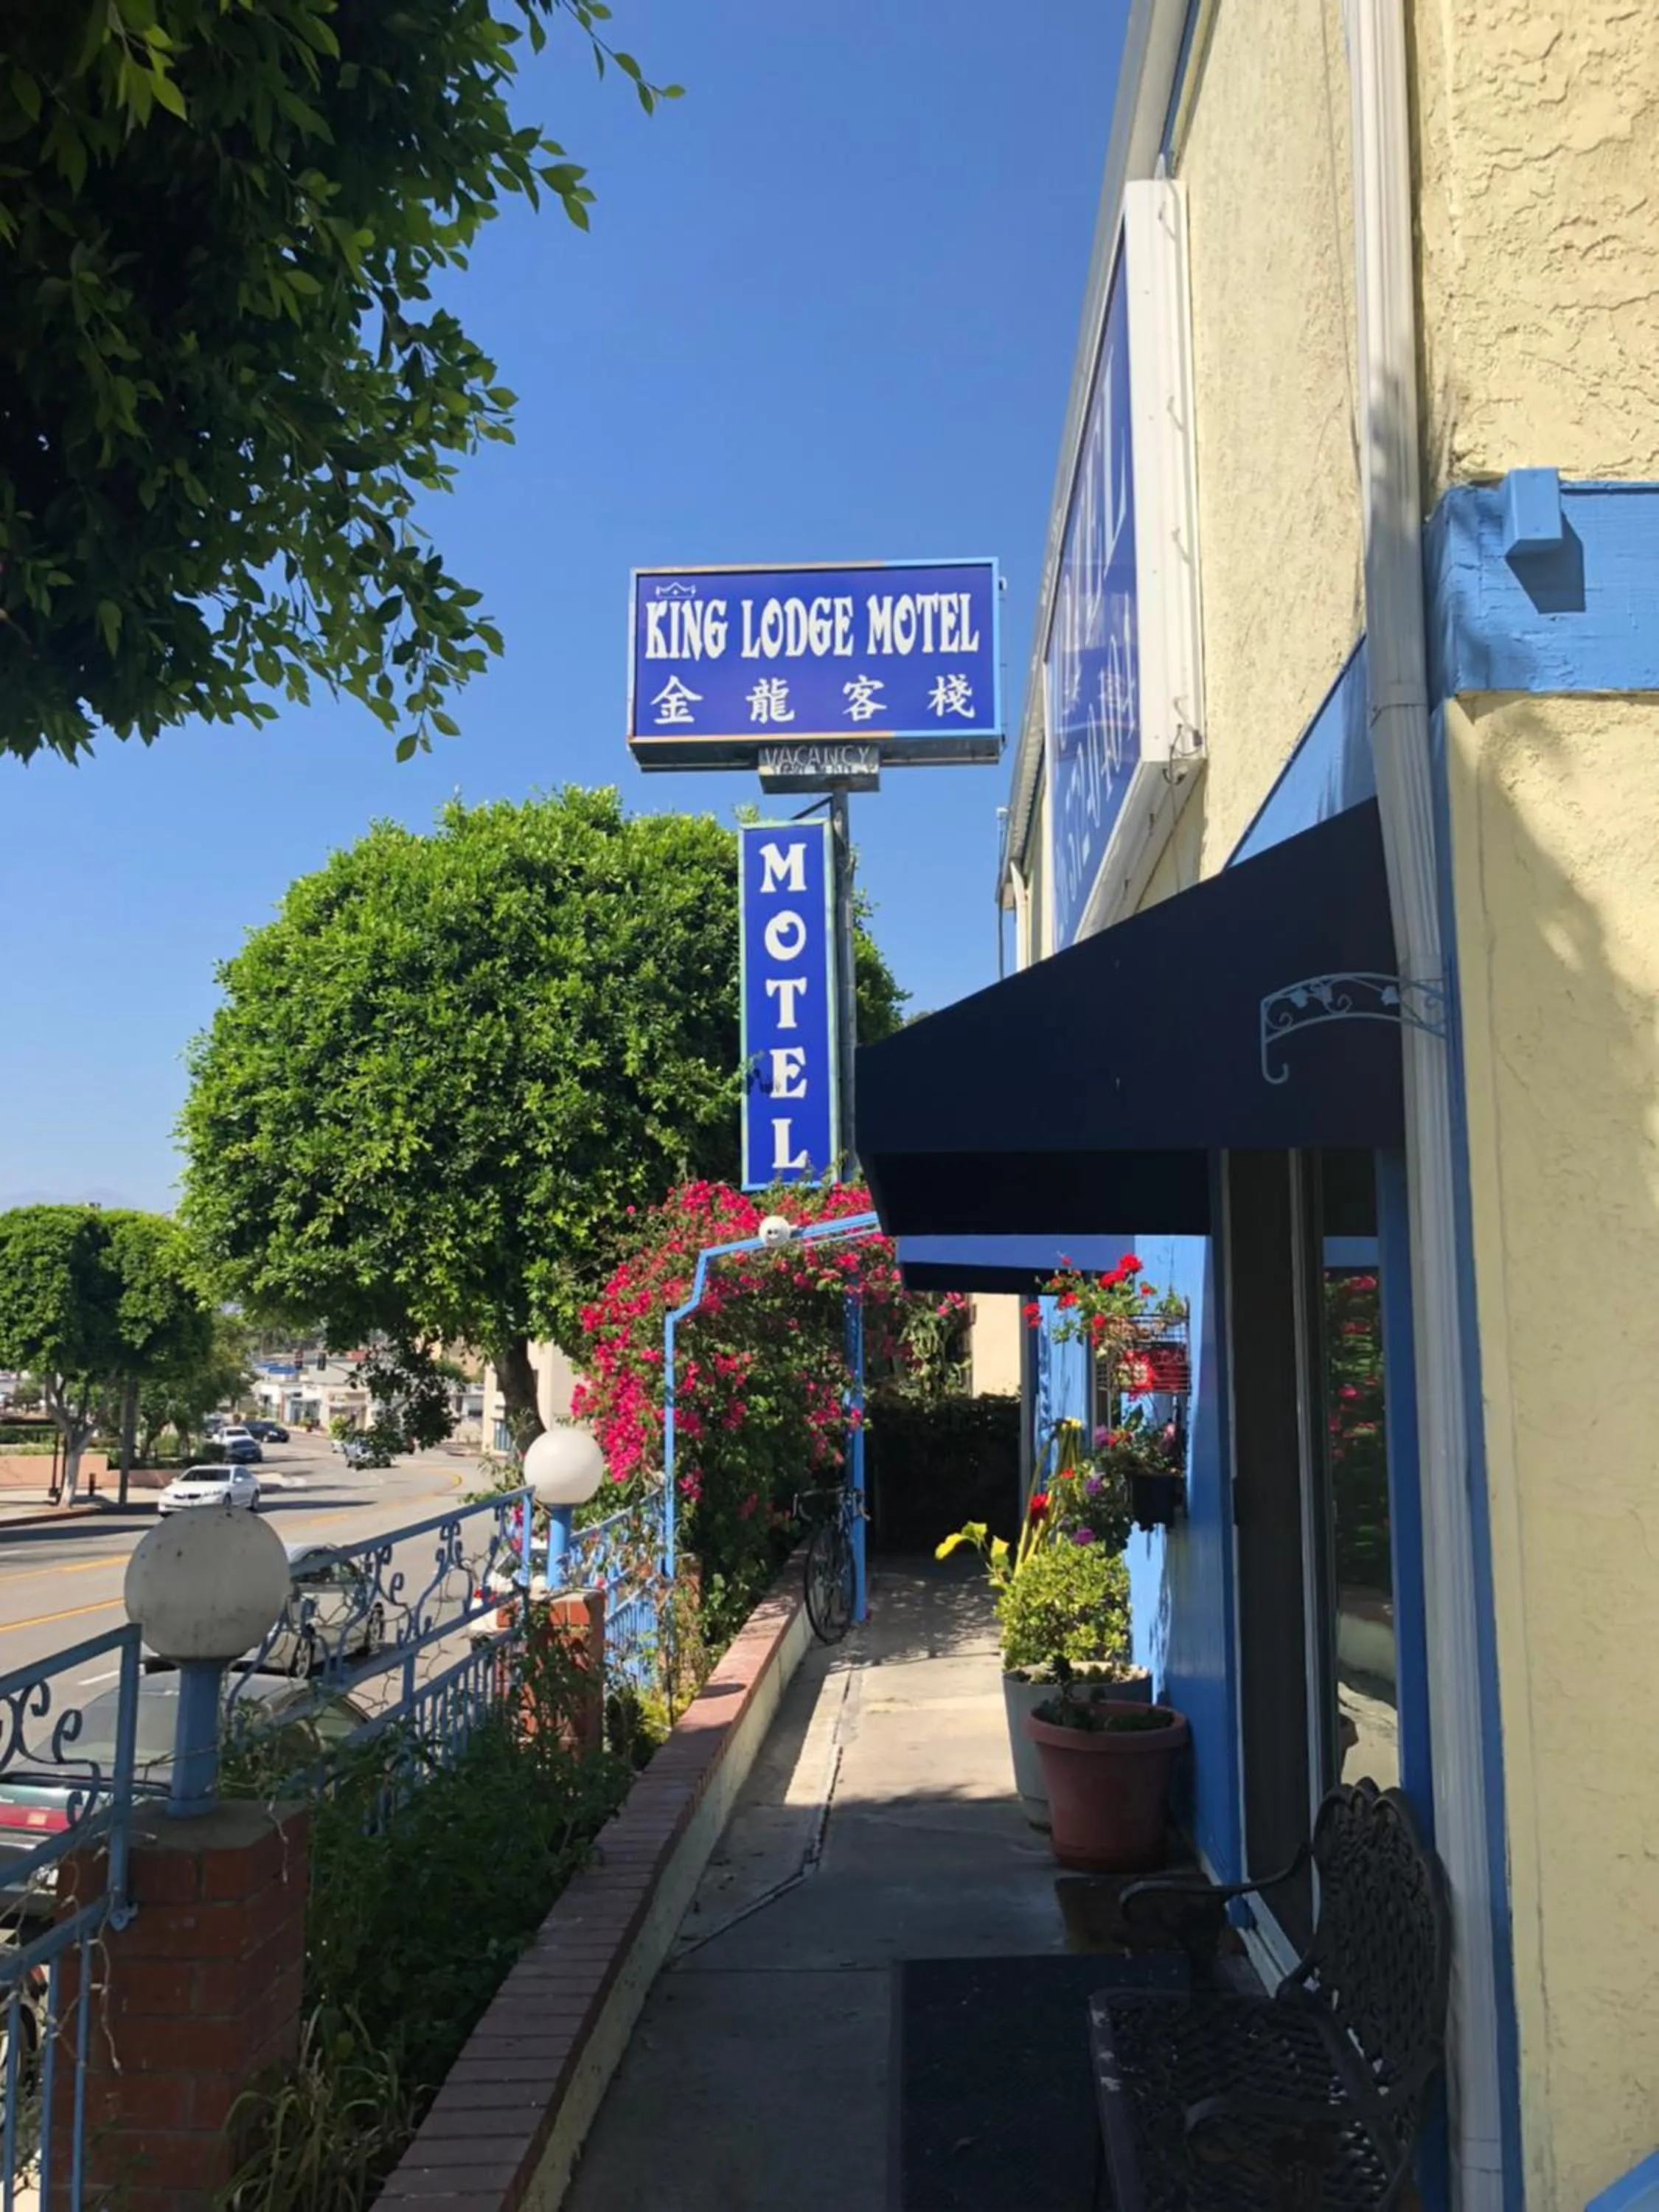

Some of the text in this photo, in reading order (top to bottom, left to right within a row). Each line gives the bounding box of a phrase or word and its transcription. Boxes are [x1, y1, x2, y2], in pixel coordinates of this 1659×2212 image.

[644, 592, 979, 661] KING LODGE MOTEL
[650, 673, 976, 726] 金龍客棧
[765, 744, 871, 768] VACANCY
[759, 842, 808, 1169] MOTEL
